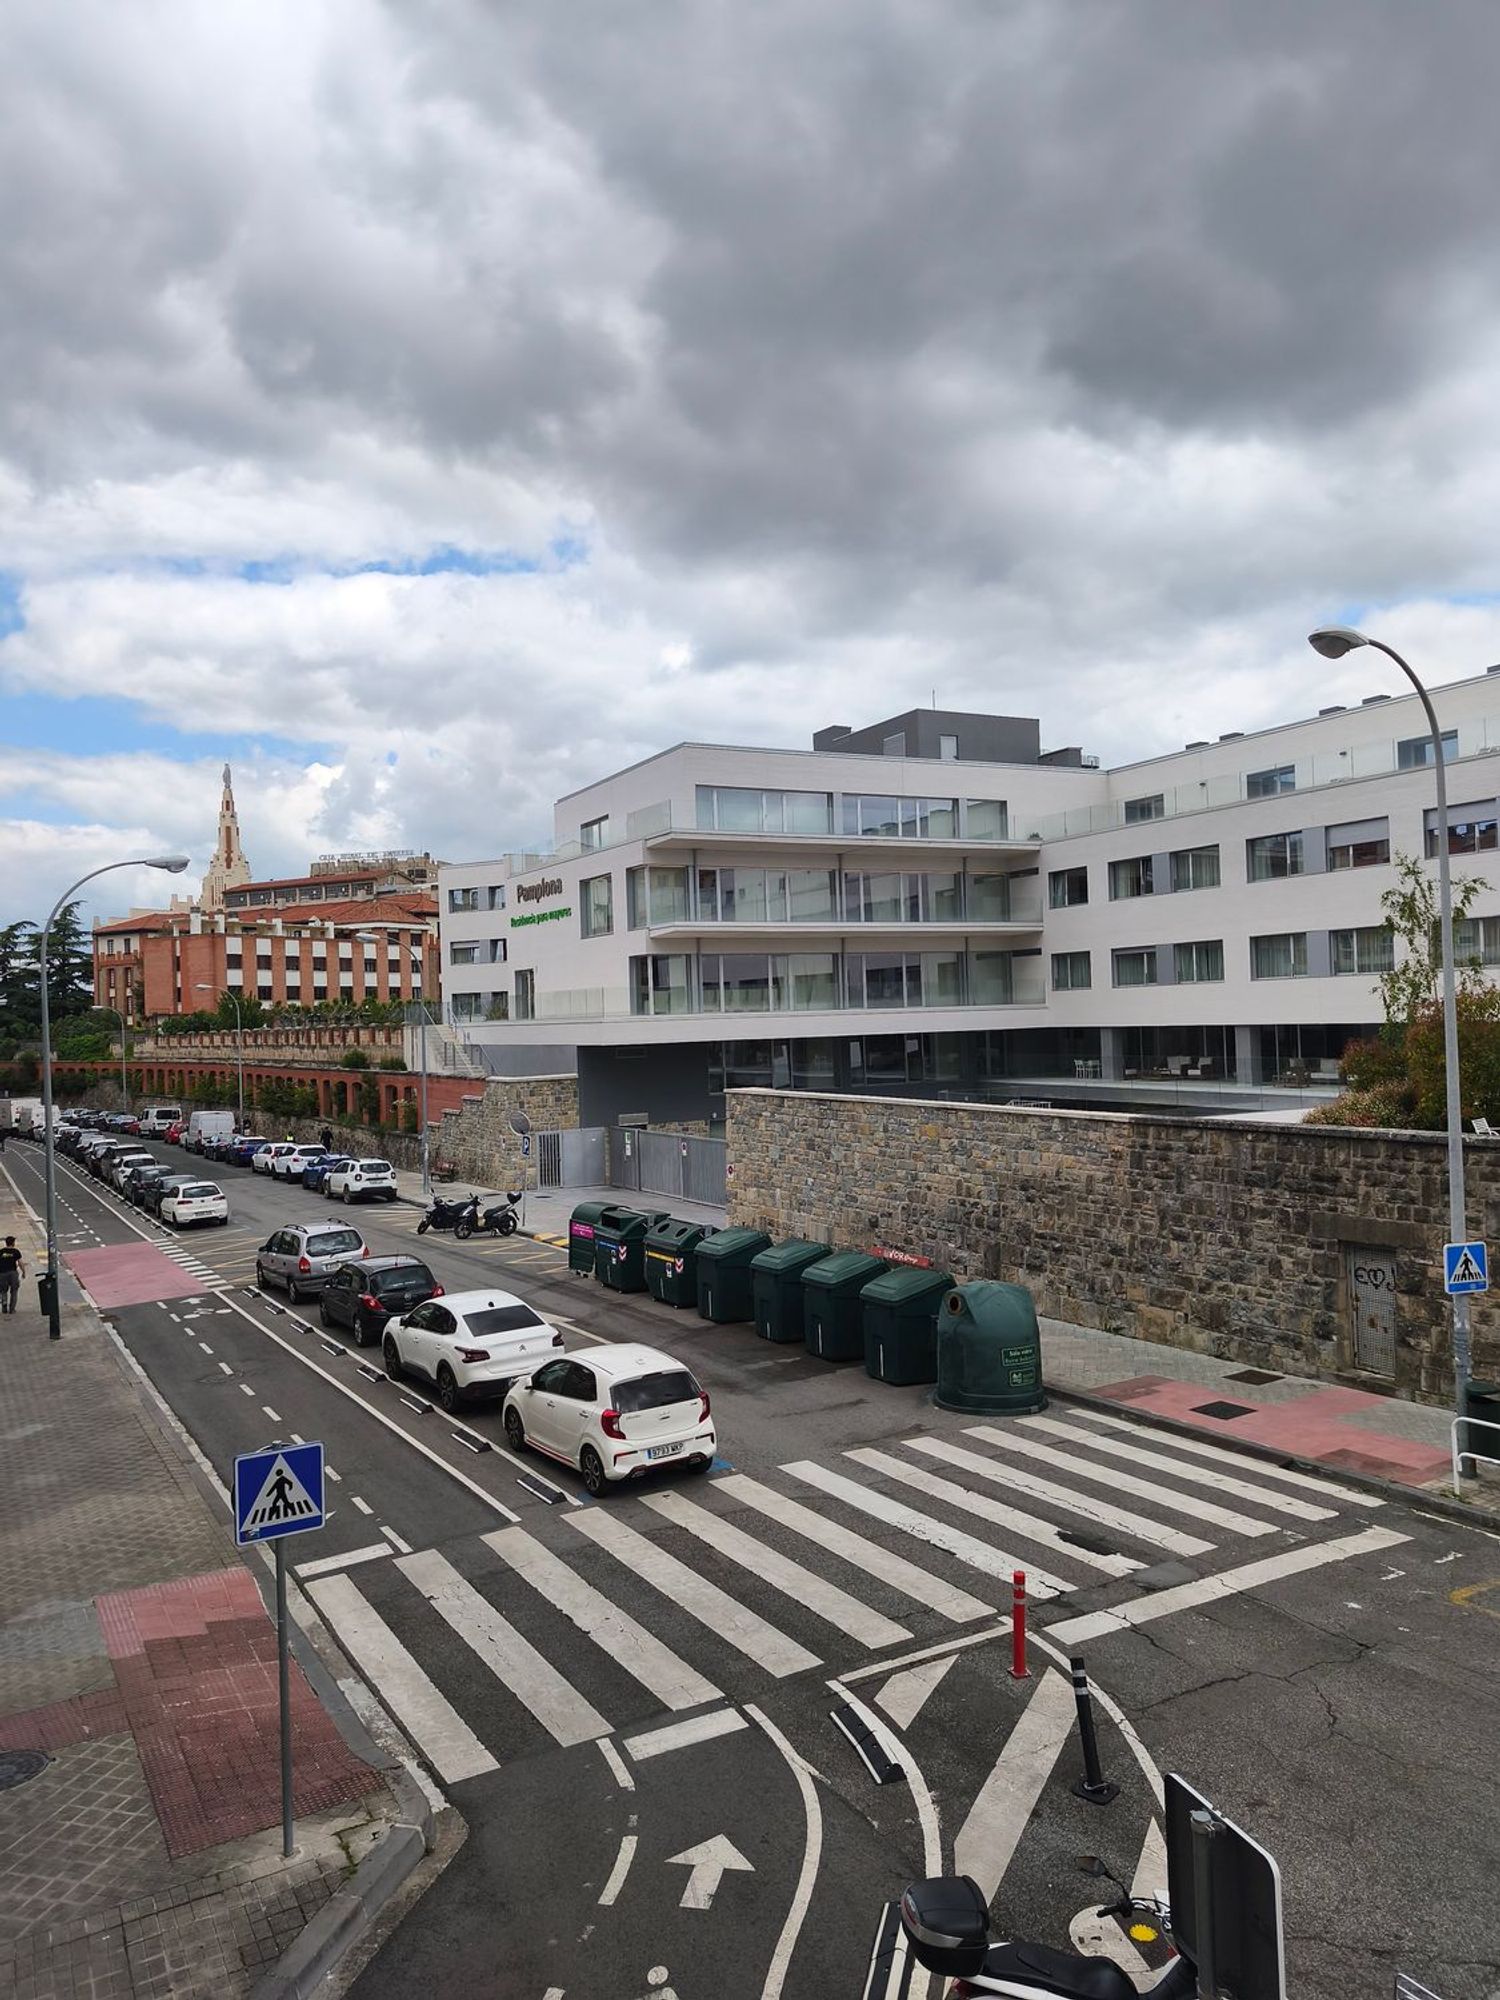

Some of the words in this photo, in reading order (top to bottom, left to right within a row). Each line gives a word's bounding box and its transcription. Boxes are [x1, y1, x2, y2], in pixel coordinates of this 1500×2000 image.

[517, 877, 563, 904] Pamplona
[510, 913, 536, 928] Residencia
[536, 912, 549, 925] para
[549, 907, 572, 921] mayores
